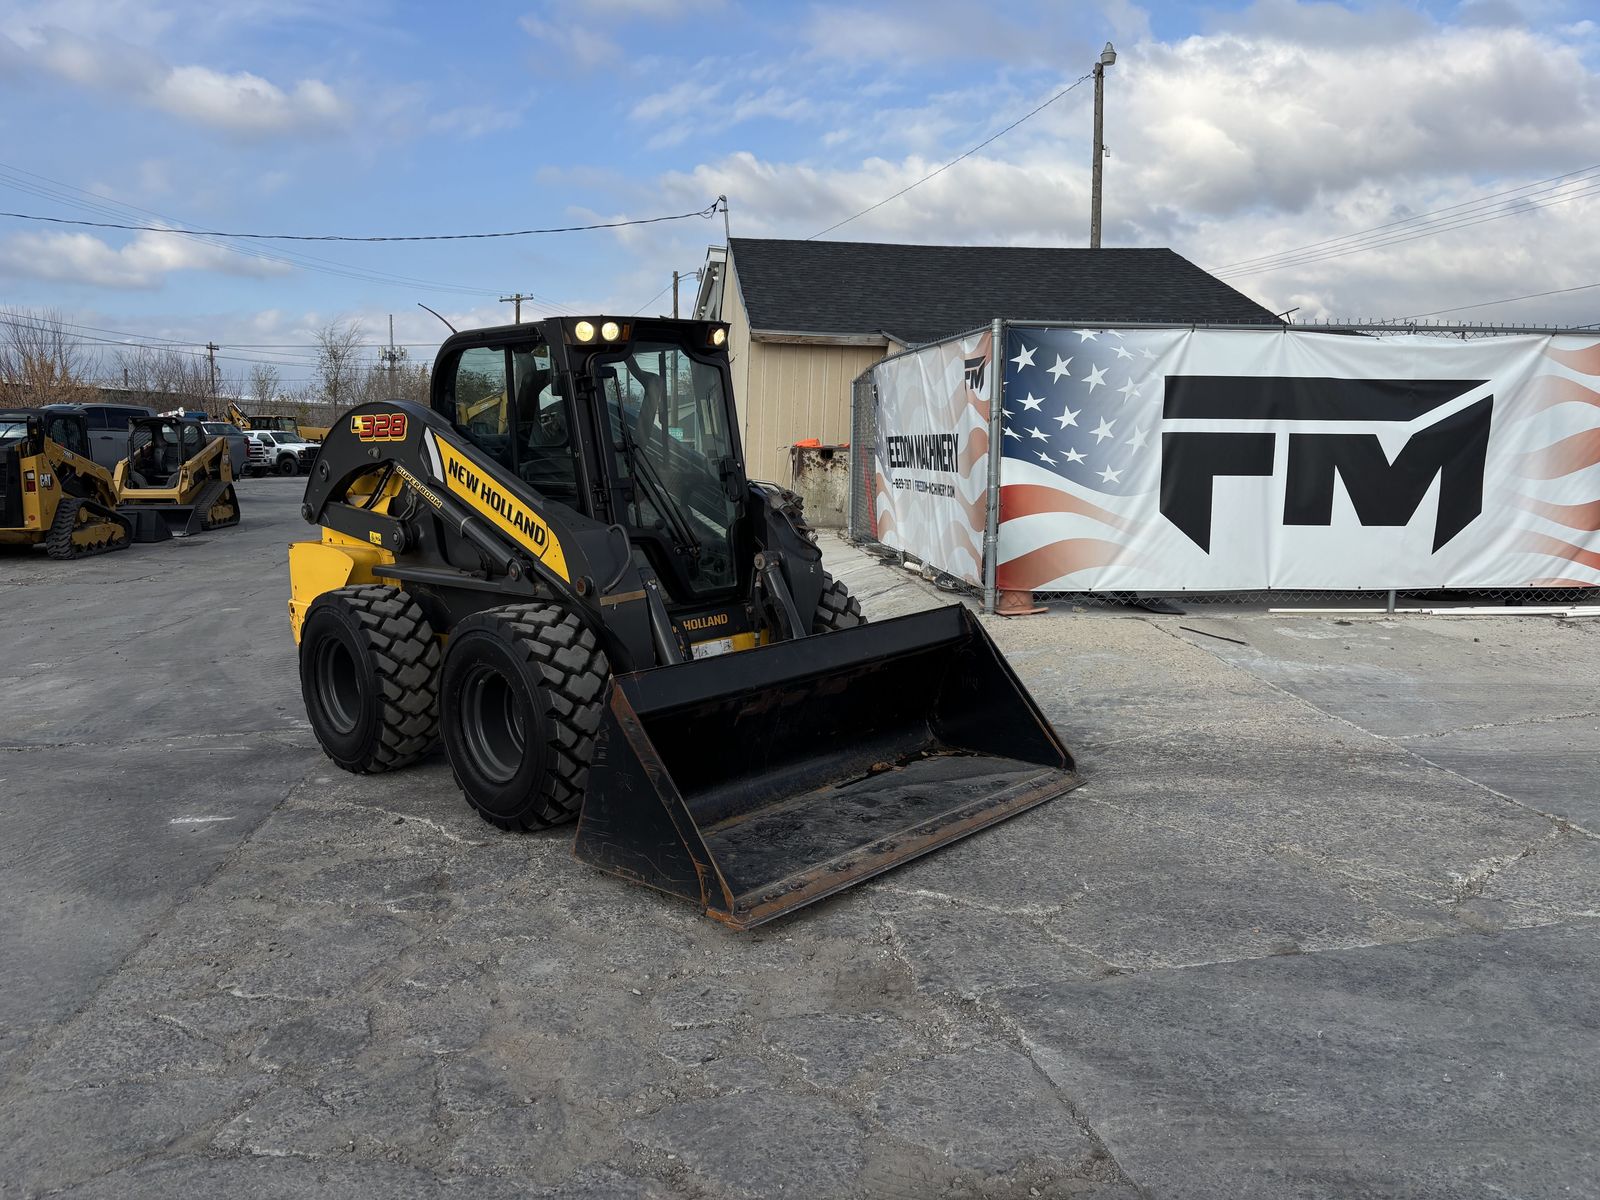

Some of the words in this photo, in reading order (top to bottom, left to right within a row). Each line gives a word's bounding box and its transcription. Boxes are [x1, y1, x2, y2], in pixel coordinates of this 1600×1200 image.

[351, 413, 407, 441] L328
[887, 434, 915, 469] EEDOM
[1159, 375, 1494, 556] FM
[40, 473, 51, 487] CAT
[397, 466, 421, 490] SUPER
[420, 485, 443, 510] BOOM
[448, 457, 479, 493] NEW
[481, 483, 546, 546] HOLLAND
[683, 613, 728, 631] HOLLAND
